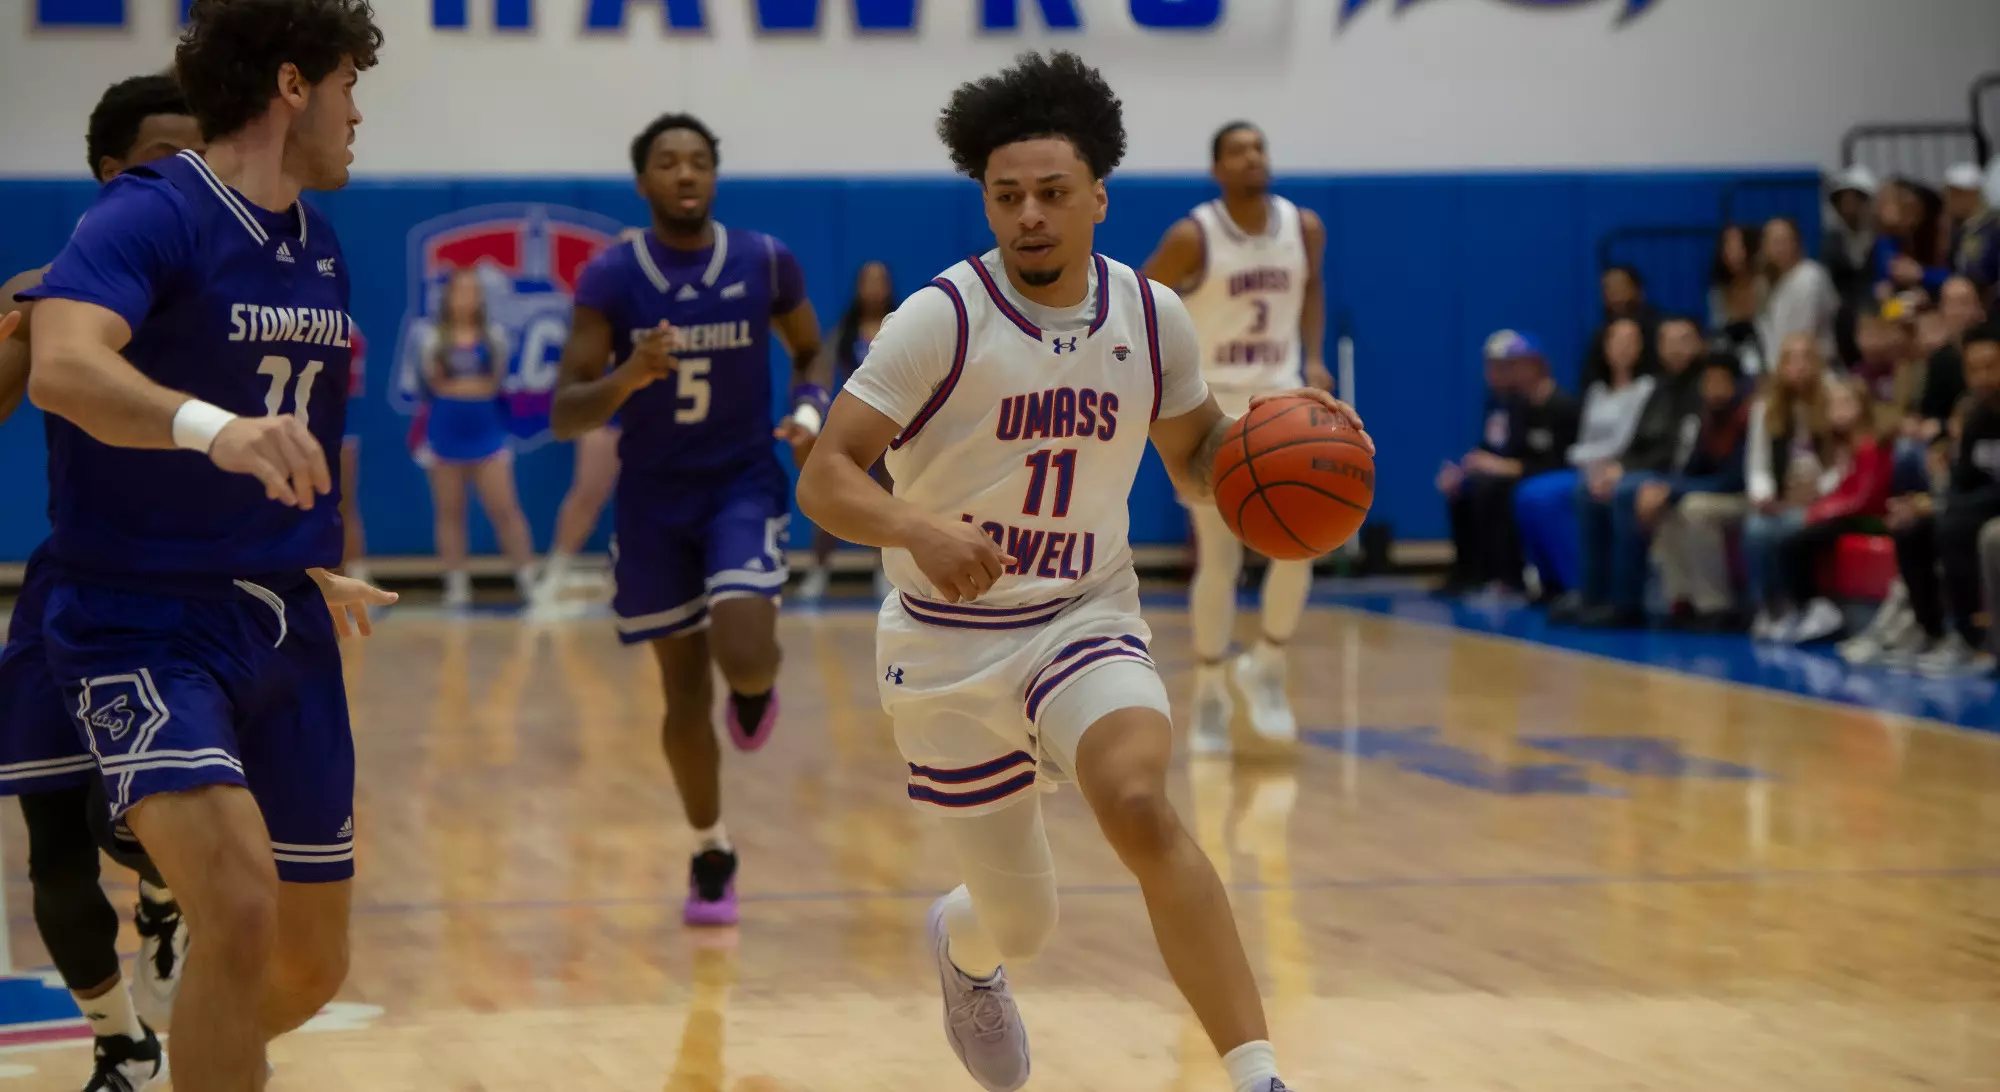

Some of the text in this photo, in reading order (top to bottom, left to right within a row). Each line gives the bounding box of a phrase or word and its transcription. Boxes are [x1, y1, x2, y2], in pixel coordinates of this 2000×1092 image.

[674, 357, 712, 424] 5
[995, 387, 1119, 441] UMASS
[1022, 449, 1078, 517] 11
